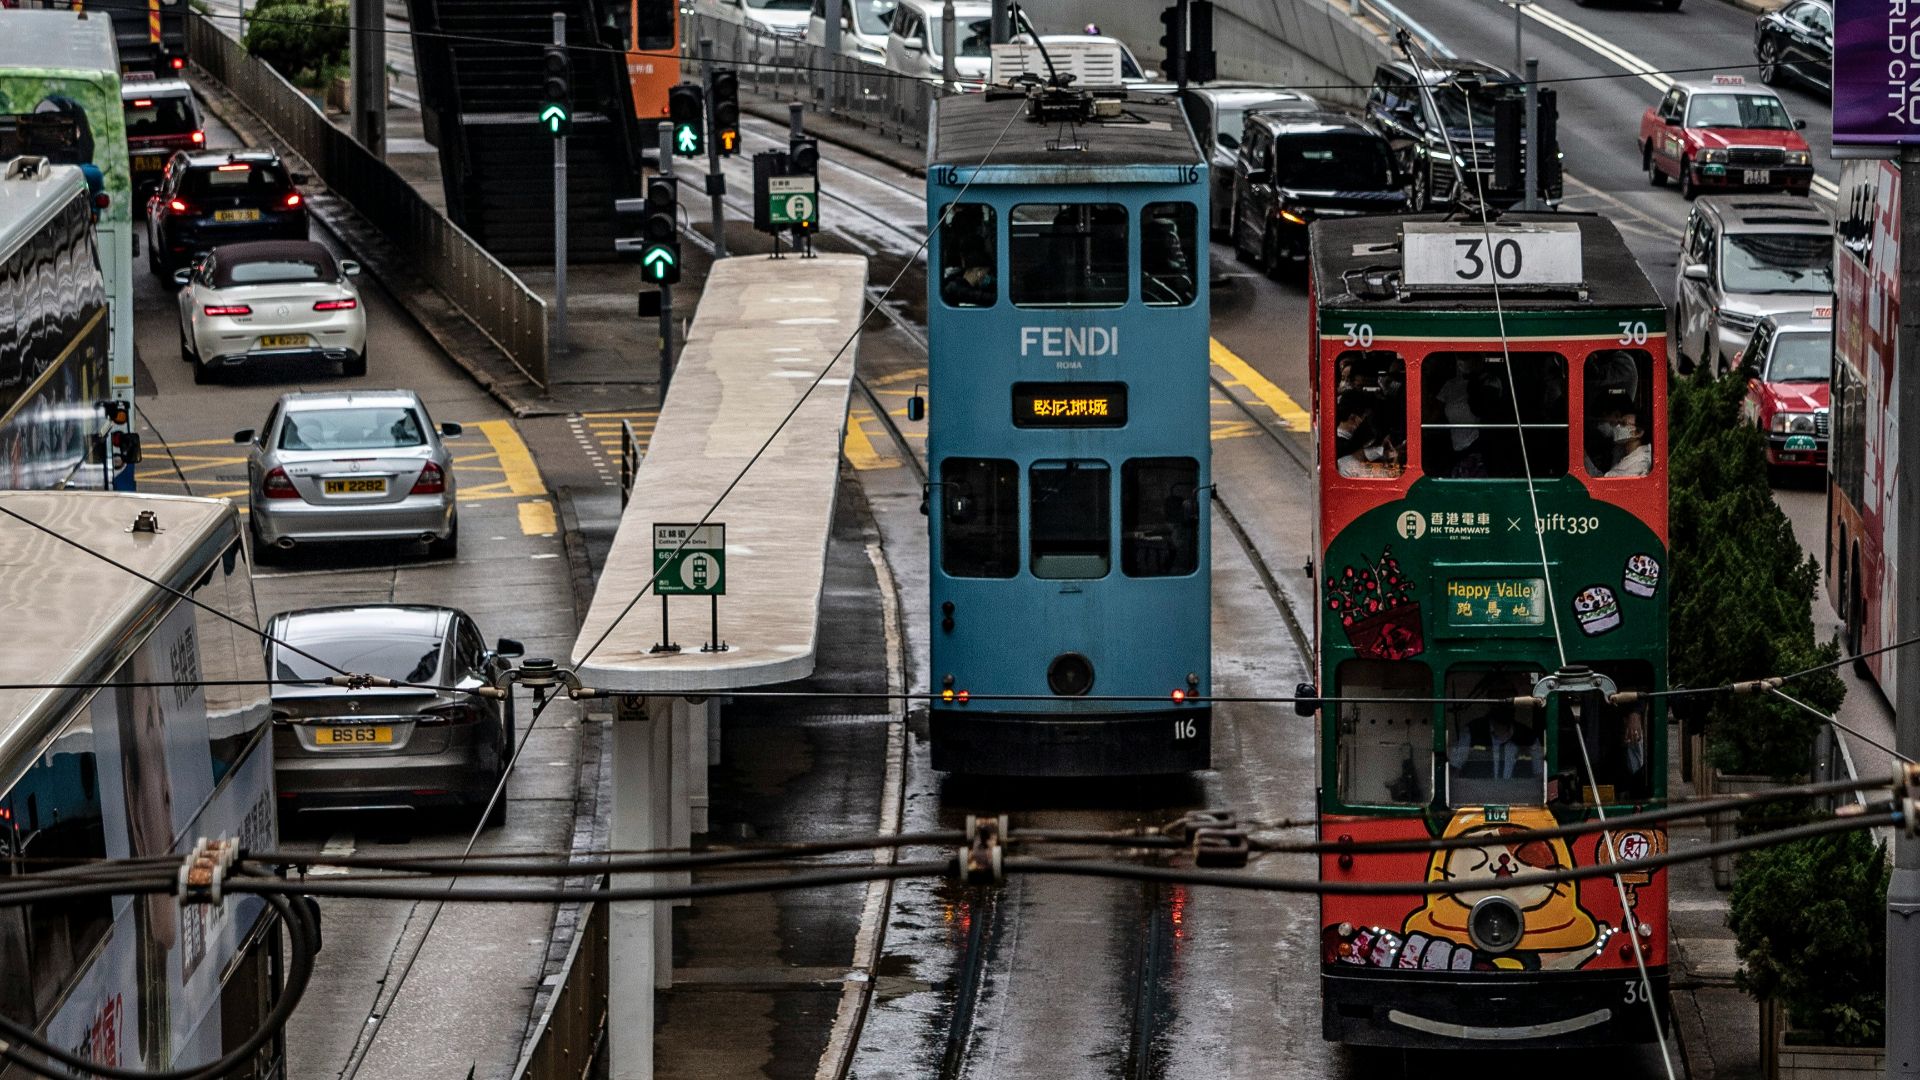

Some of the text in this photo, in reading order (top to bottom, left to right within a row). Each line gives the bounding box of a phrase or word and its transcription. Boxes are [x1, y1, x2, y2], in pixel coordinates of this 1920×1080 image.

[1715, 77, 1742, 85] TAXI
[1888, 59, 1906, 124] CITY
[937, 166, 959, 185] 116
[1177, 165, 1199, 184] 116
[1455, 238, 1523, 280] 30
[1020, 326, 1119, 356] FENDI
[1343, 323, 1373, 347] 30
[1618, 321, 1648, 346] 30
[1056, 361, 1082, 369] ROMA
[327, 479, 384, 492] HW 2282
[1430, 512, 1490, 526] 香港電車
[1535, 513, 1599, 534] gift330
[1430, 526, 1490, 534] HK TRAMWAYS
[1447, 581, 1539, 599] Happy Valley
[1456, 600, 1530, 619] 跑馬地
[332, 728, 376, 742] BS 63
[1174, 718, 1197, 739] 116
[1487, 809, 1508, 821] 104
[1623, 835, 1647, 860] 財
[1623, 980, 1652, 1004] 30
